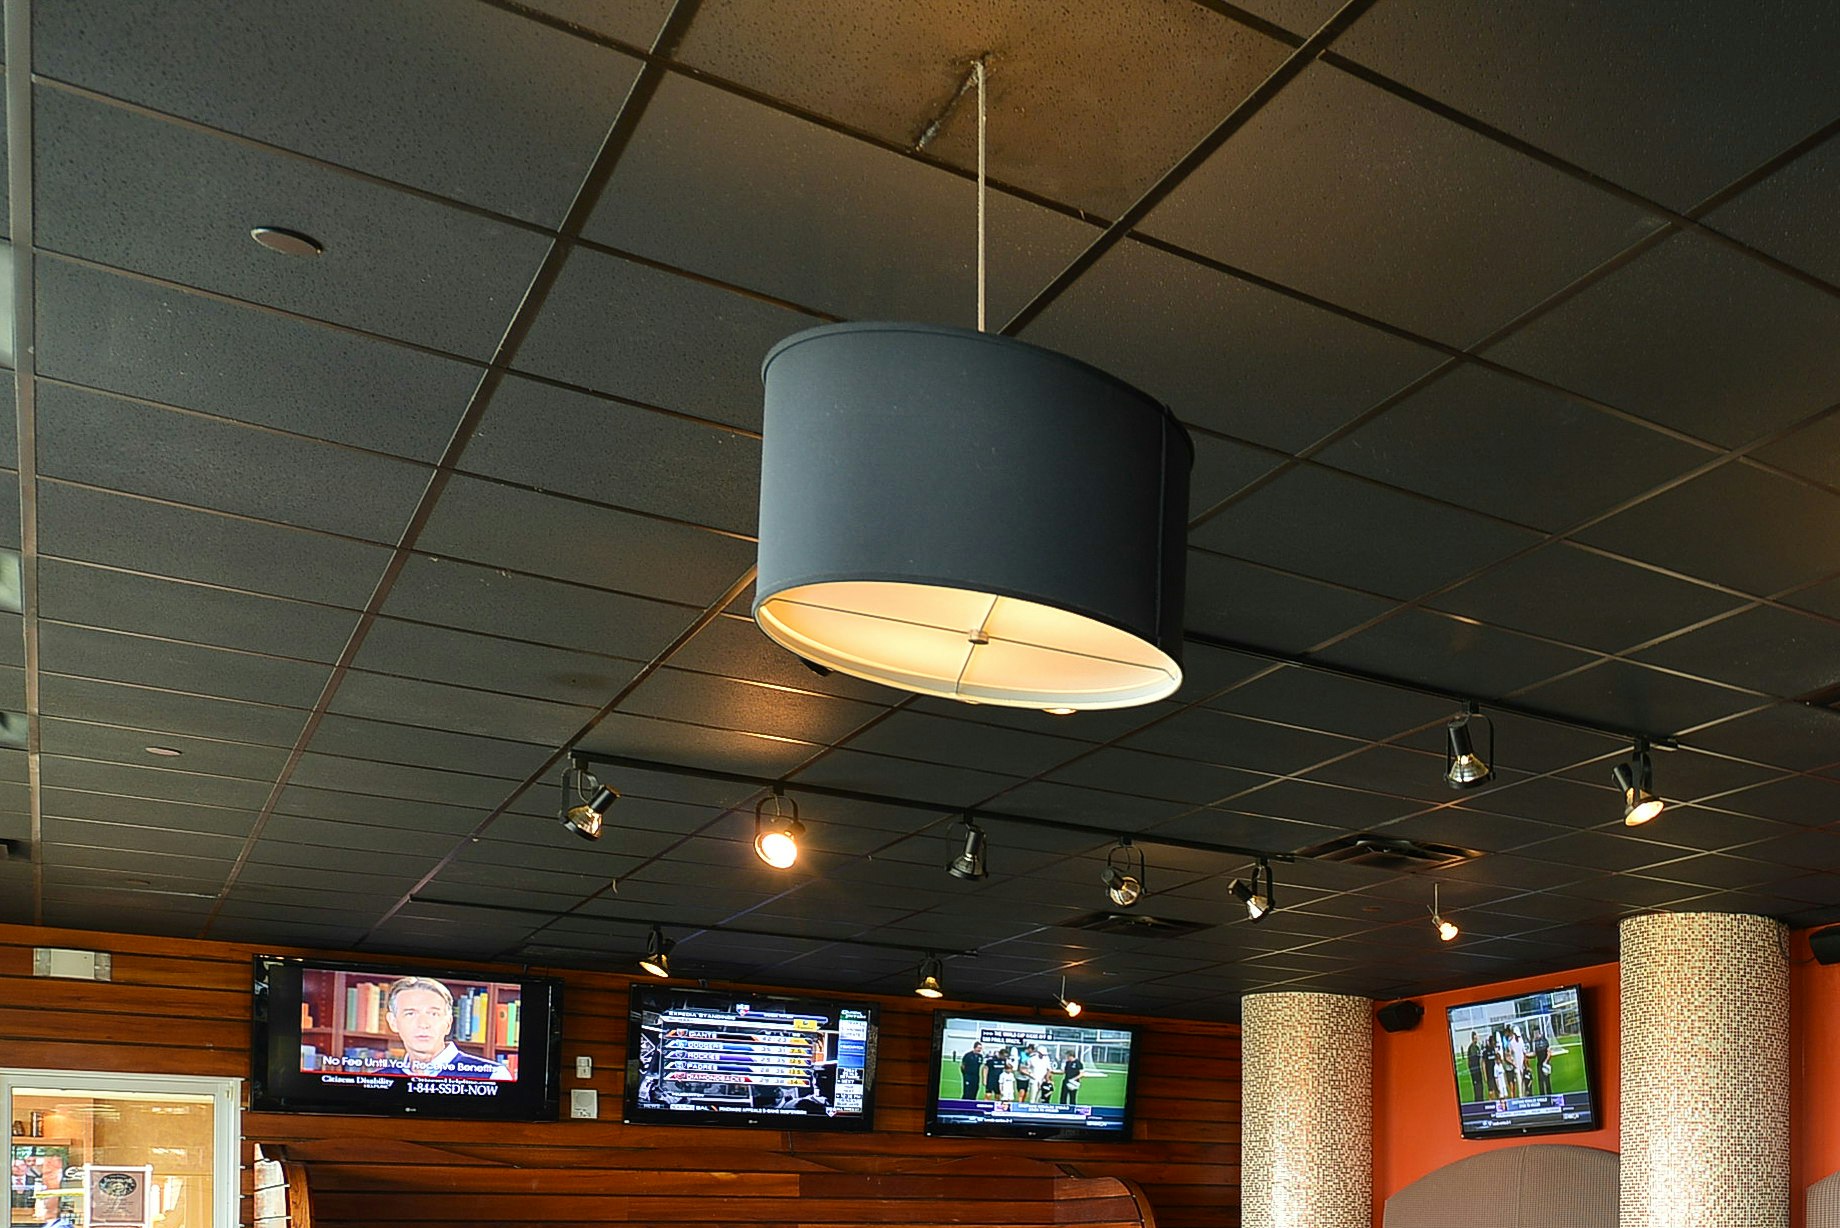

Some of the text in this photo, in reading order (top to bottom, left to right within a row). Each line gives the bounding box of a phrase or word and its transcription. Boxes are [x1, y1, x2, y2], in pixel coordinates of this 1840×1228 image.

[322, 1056, 341, 1066] No
[342, 1056, 363, 1067] Fee
[364, 1058, 387, 1068] Until
[389, 1058, 411, 1069] You
[406, 1082, 499, 1096] 1-844-SSDI-NOW
